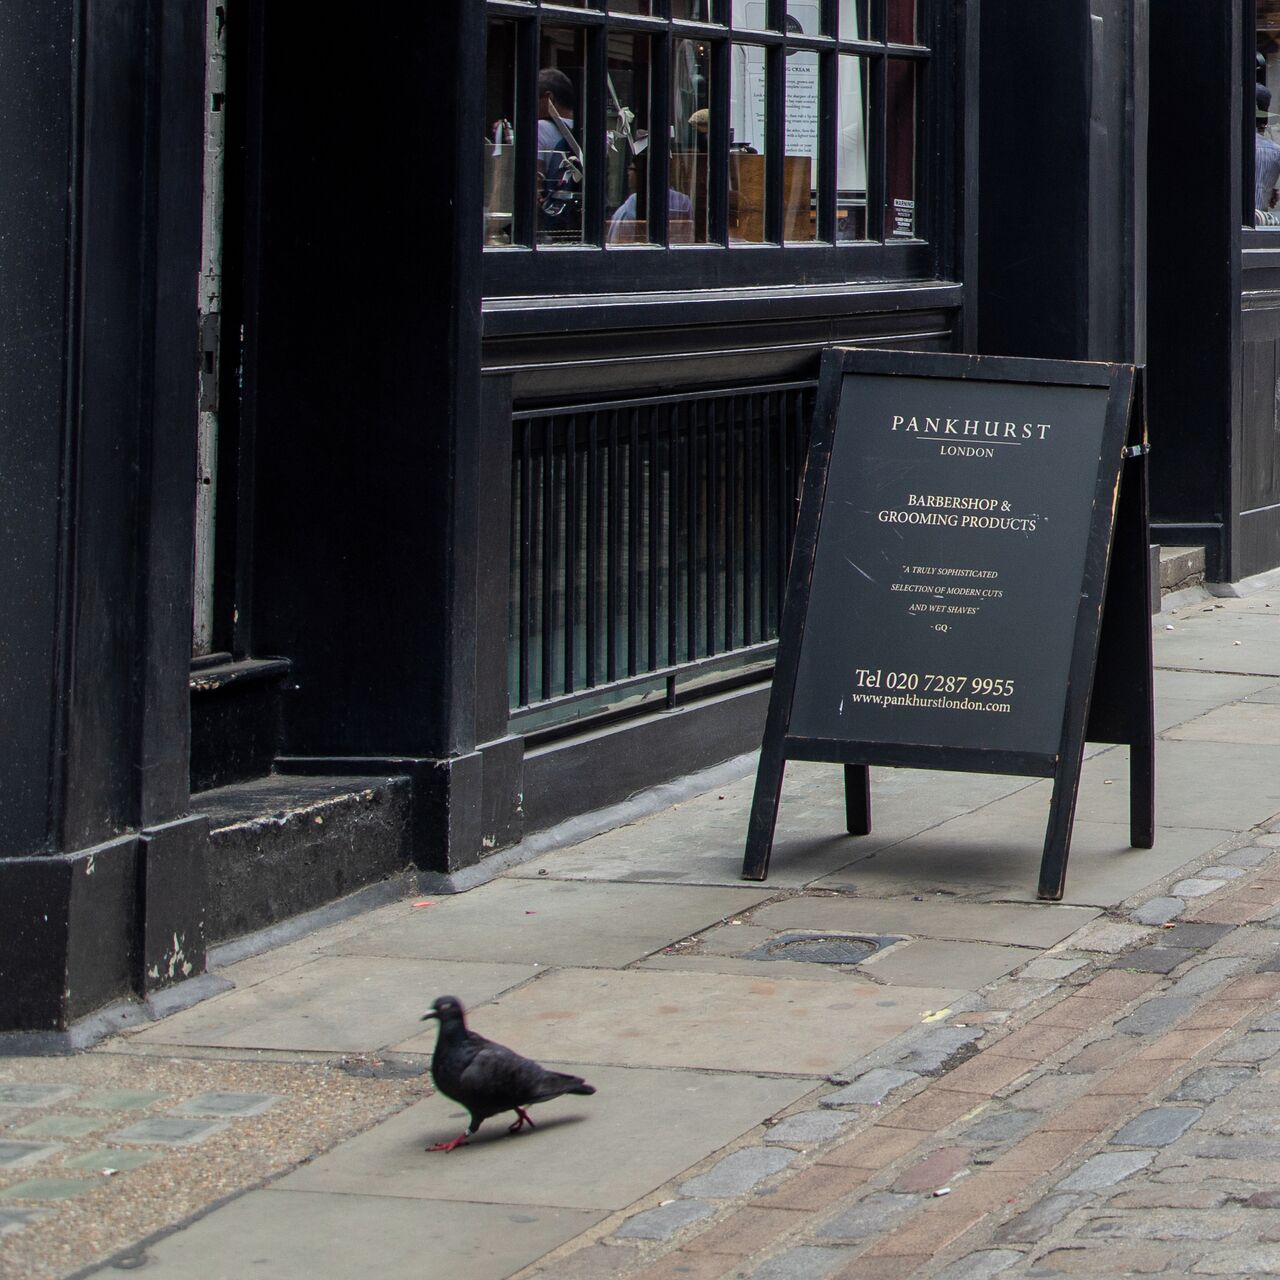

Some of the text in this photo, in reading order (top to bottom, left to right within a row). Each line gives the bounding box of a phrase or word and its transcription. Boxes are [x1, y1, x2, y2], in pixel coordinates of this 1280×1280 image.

[891, 415, 1052, 441] PANKHURST
[940, 445, 995, 459] LONDON
[907, 494, 1012, 512] BARBERSHOP &
[878, 510, 1036, 532] GROOMING PRODUCTS
[912, 566, 936, 576] TRULY
[937, 567, 998, 579] SOPHISTICATED
[890, 583, 1004, 598] SELECTION OF MODERN CUTS
[909, 603, 928, 613] AND
[928, 604, 945, 614] WET
[934, 623, 948, 633] GQ
[855, 669, 1015, 696] Tel 020 7287 9955
[852, 692, 1012, 713] www.pankhurstlondon.com
